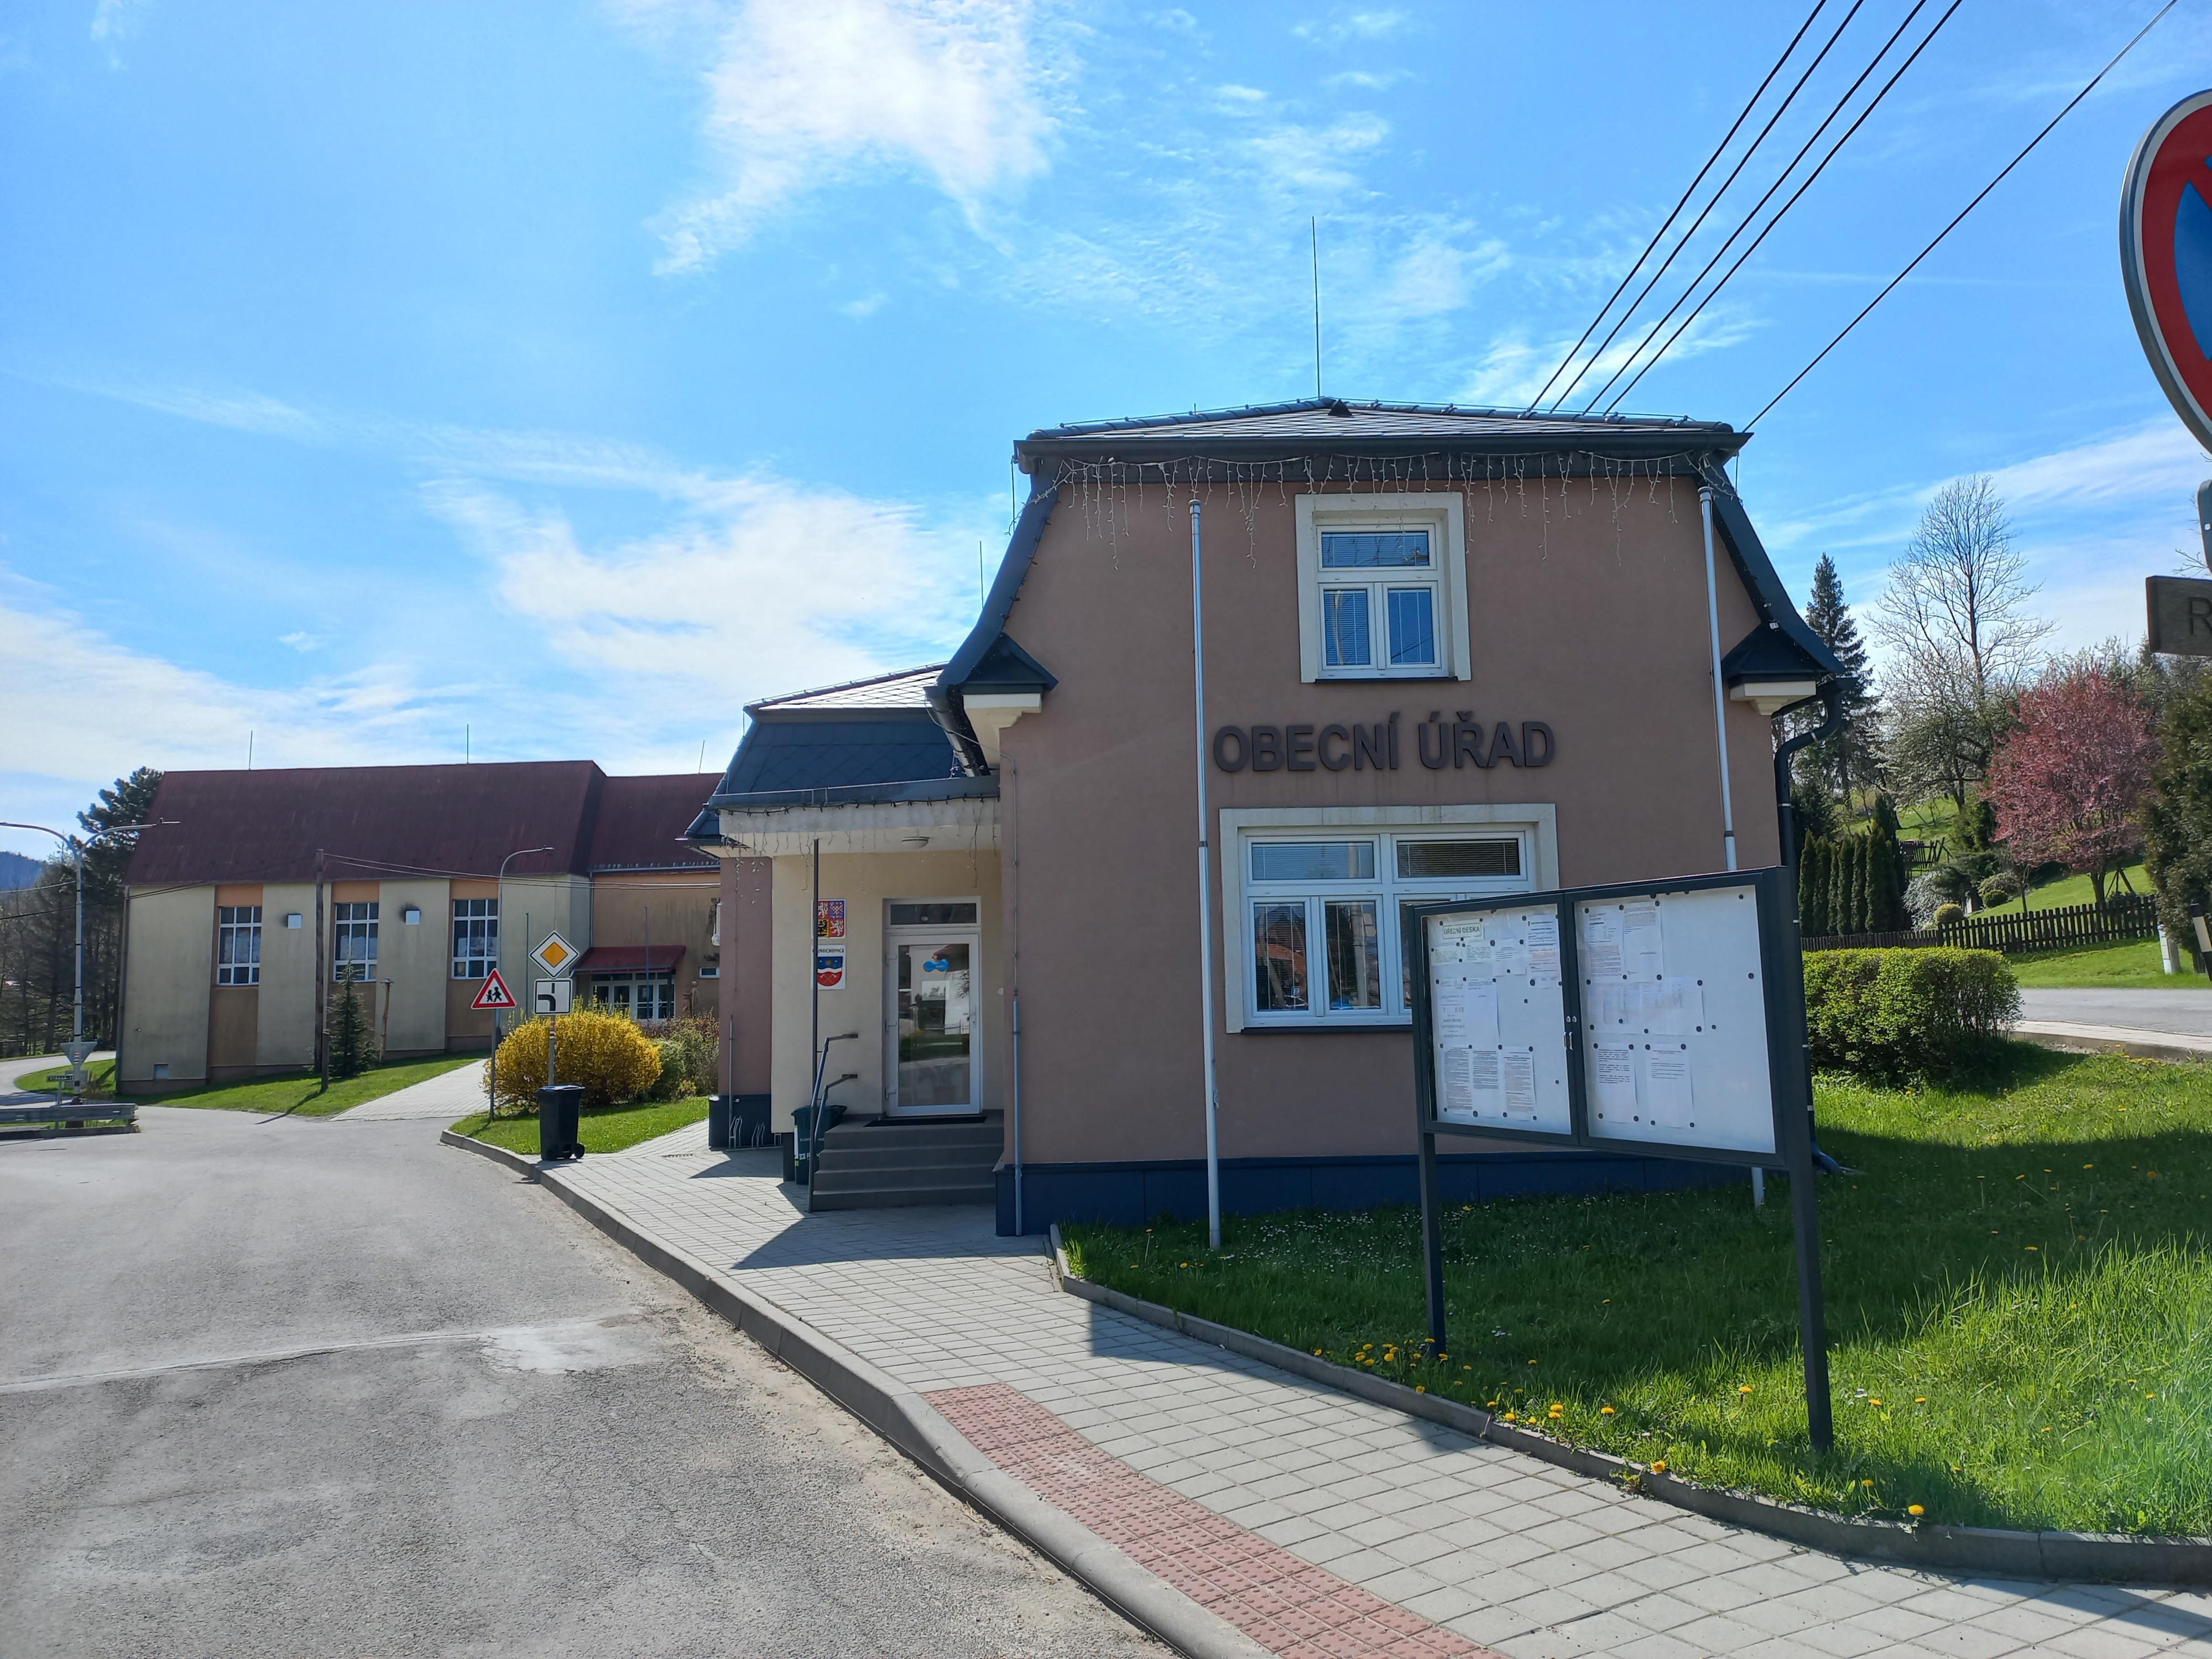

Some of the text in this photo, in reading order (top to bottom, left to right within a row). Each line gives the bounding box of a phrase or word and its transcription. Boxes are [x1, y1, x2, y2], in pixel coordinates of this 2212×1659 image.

[1213, 711, 1555, 772] OBECNÍ ÚŘAD
[1444, 926, 1462, 935] ÚŘEDNÍ
